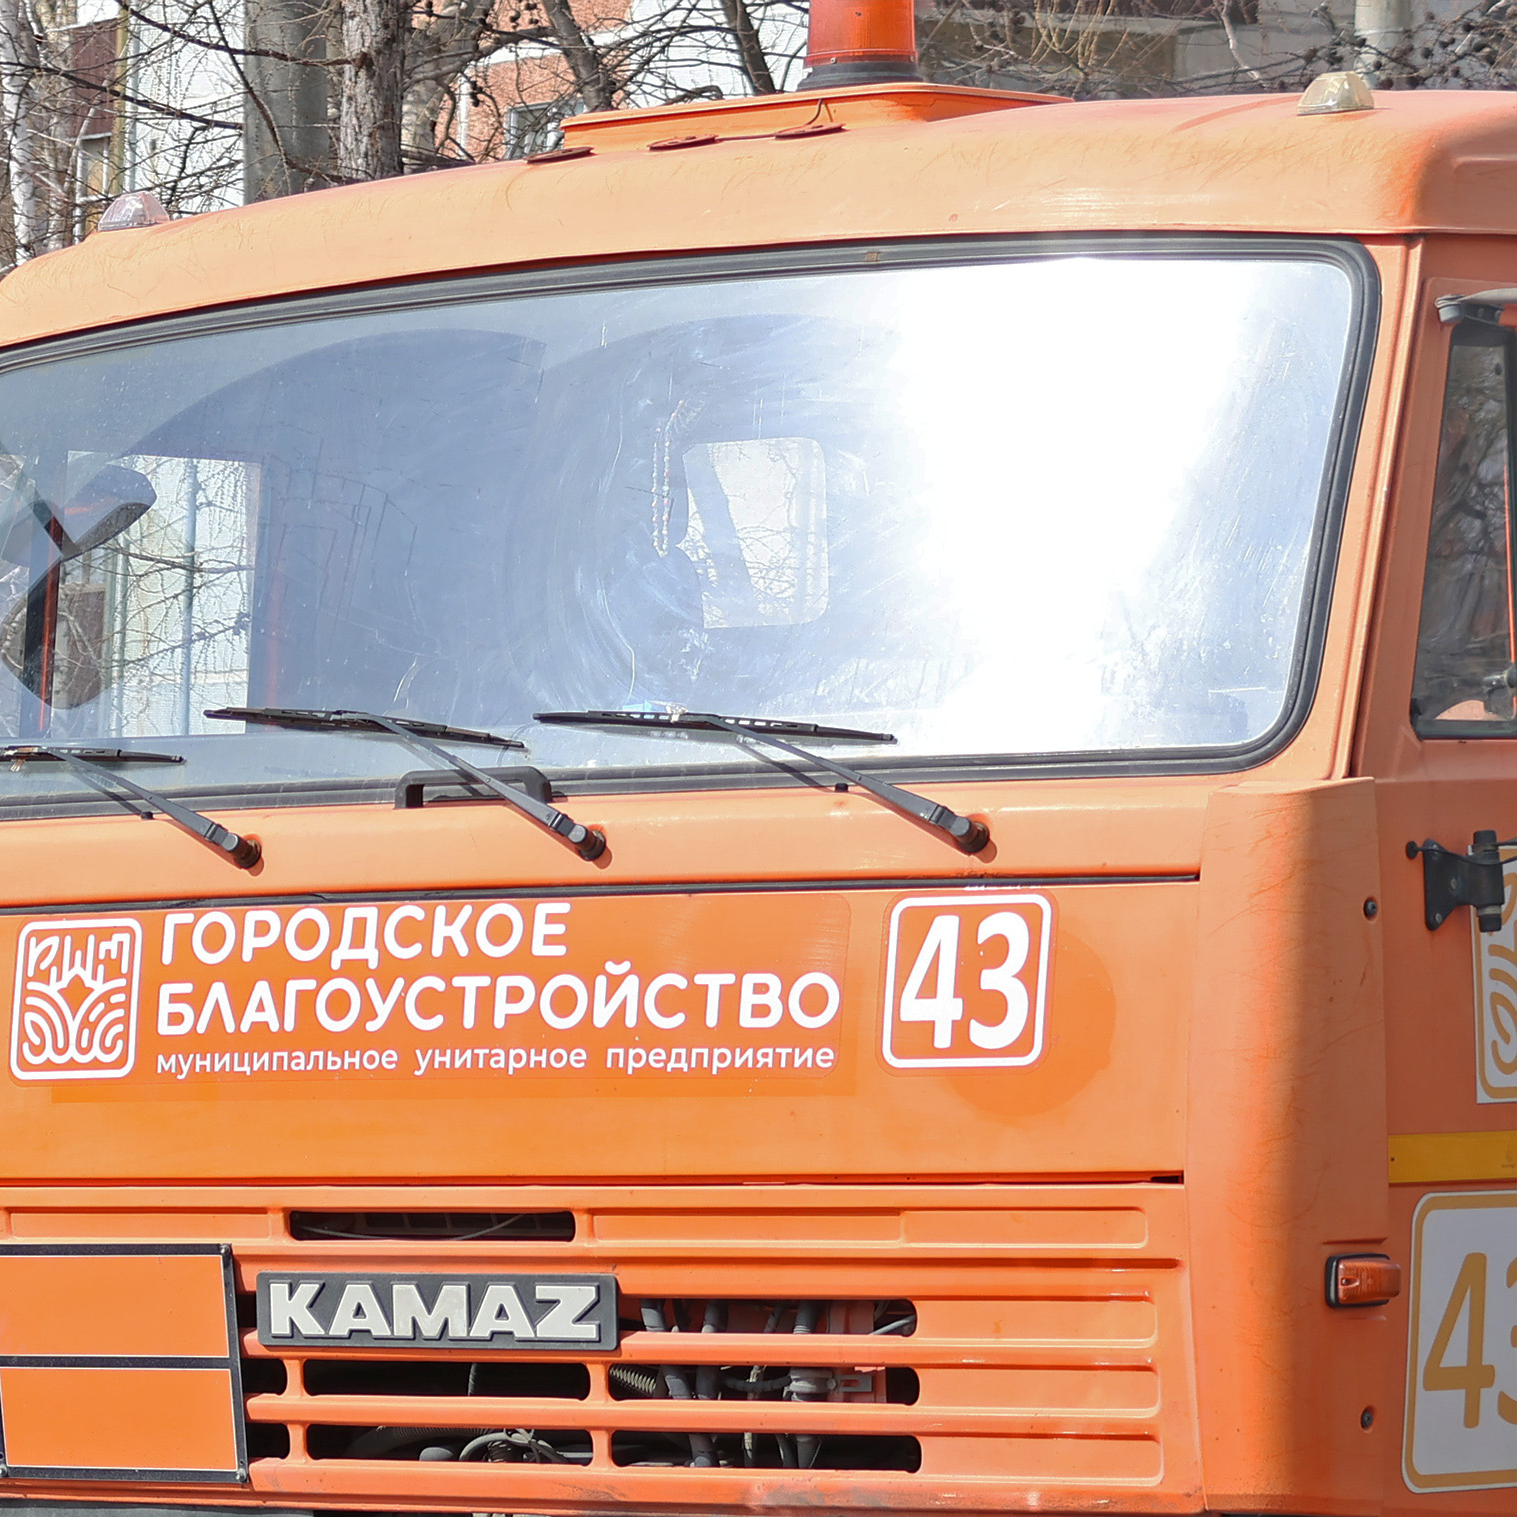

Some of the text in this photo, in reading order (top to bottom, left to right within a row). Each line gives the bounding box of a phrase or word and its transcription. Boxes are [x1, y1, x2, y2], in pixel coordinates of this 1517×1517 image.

[160, 901, 571, 970] ГОРОДСКОЕ
[156, 961, 841, 1036] БЛАГОУСТРОЙСТВО
[896, 910, 1033, 1051] 43
[156, 1043, 835, 1080] муниципальное унитарное предприятие
[270, 1282, 602, 1340] KAMAZ
[1423, 1252, 1517, 1430] 4
